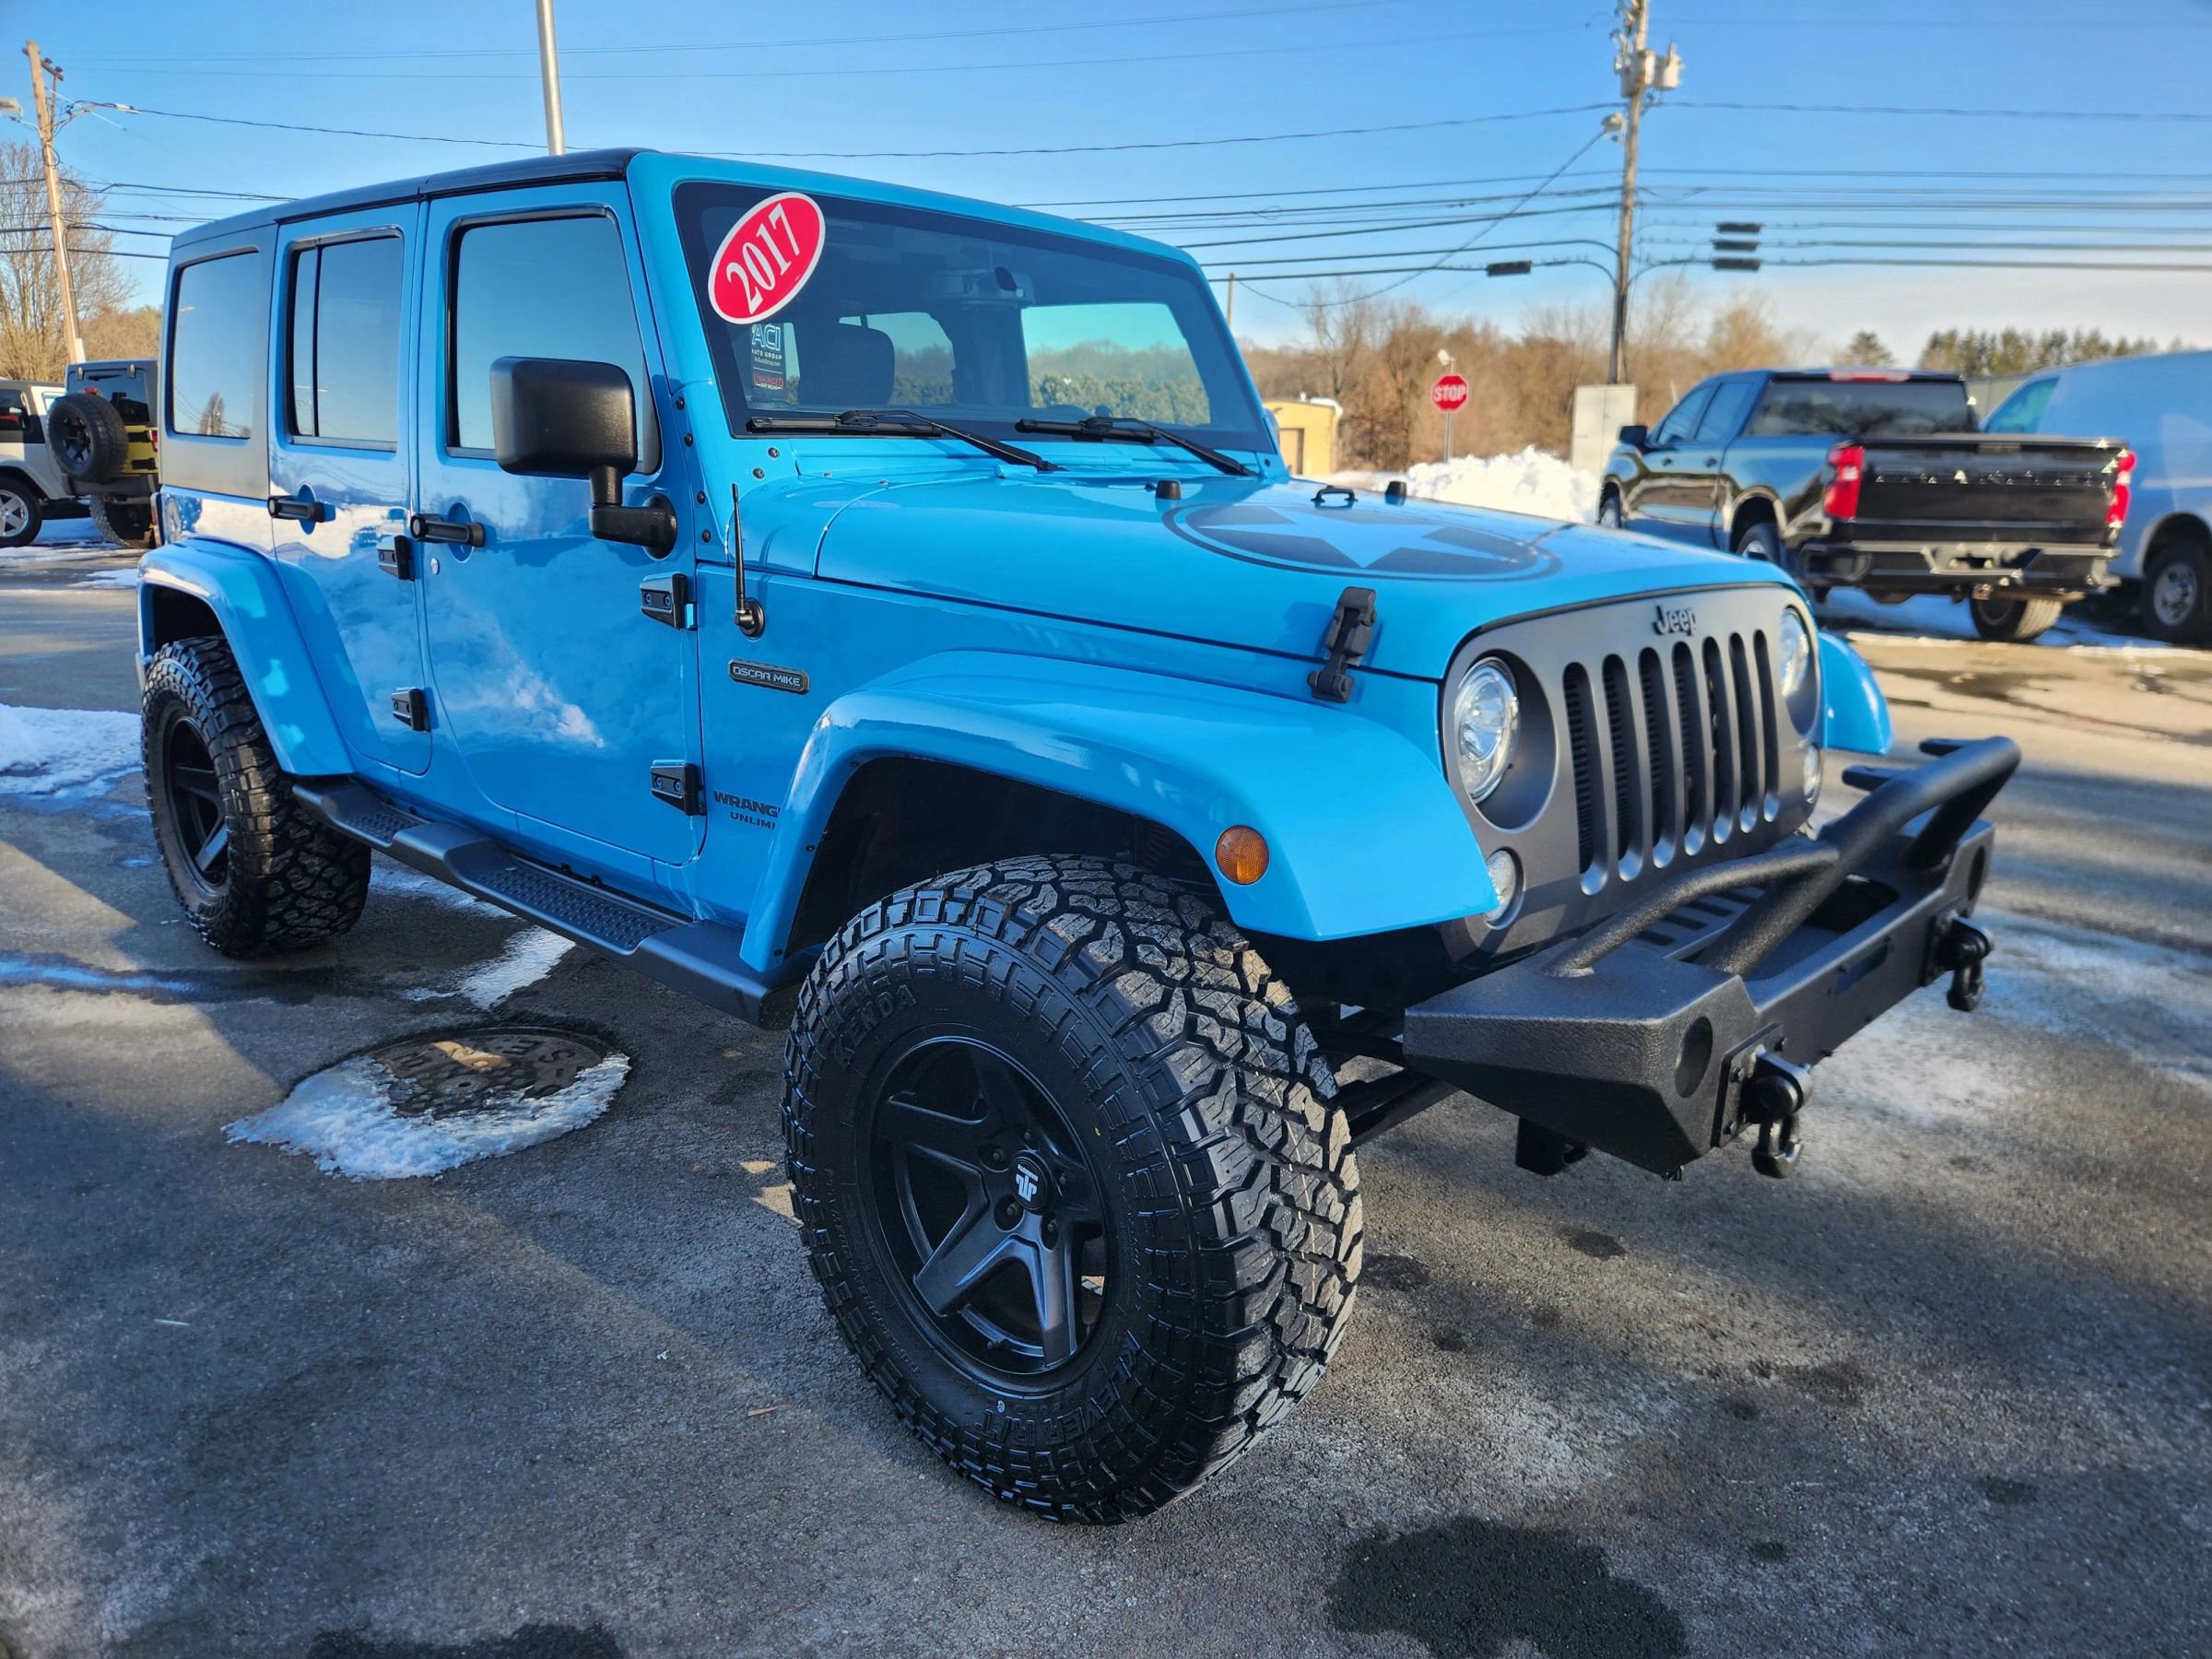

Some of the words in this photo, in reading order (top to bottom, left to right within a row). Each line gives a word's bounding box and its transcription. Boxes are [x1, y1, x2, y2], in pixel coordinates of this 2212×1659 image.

[725, 203, 800, 315] 2017
[751, 324, 781, 351] ACI
[1433, 385, 1467, 402] STOP
[1653, 605, 1698, 637] Jeep
[733, 665, 771, 681] OSCAR
[773, 674, 801, 688] MIKE
[712, 790, 782, 818] WRANG
